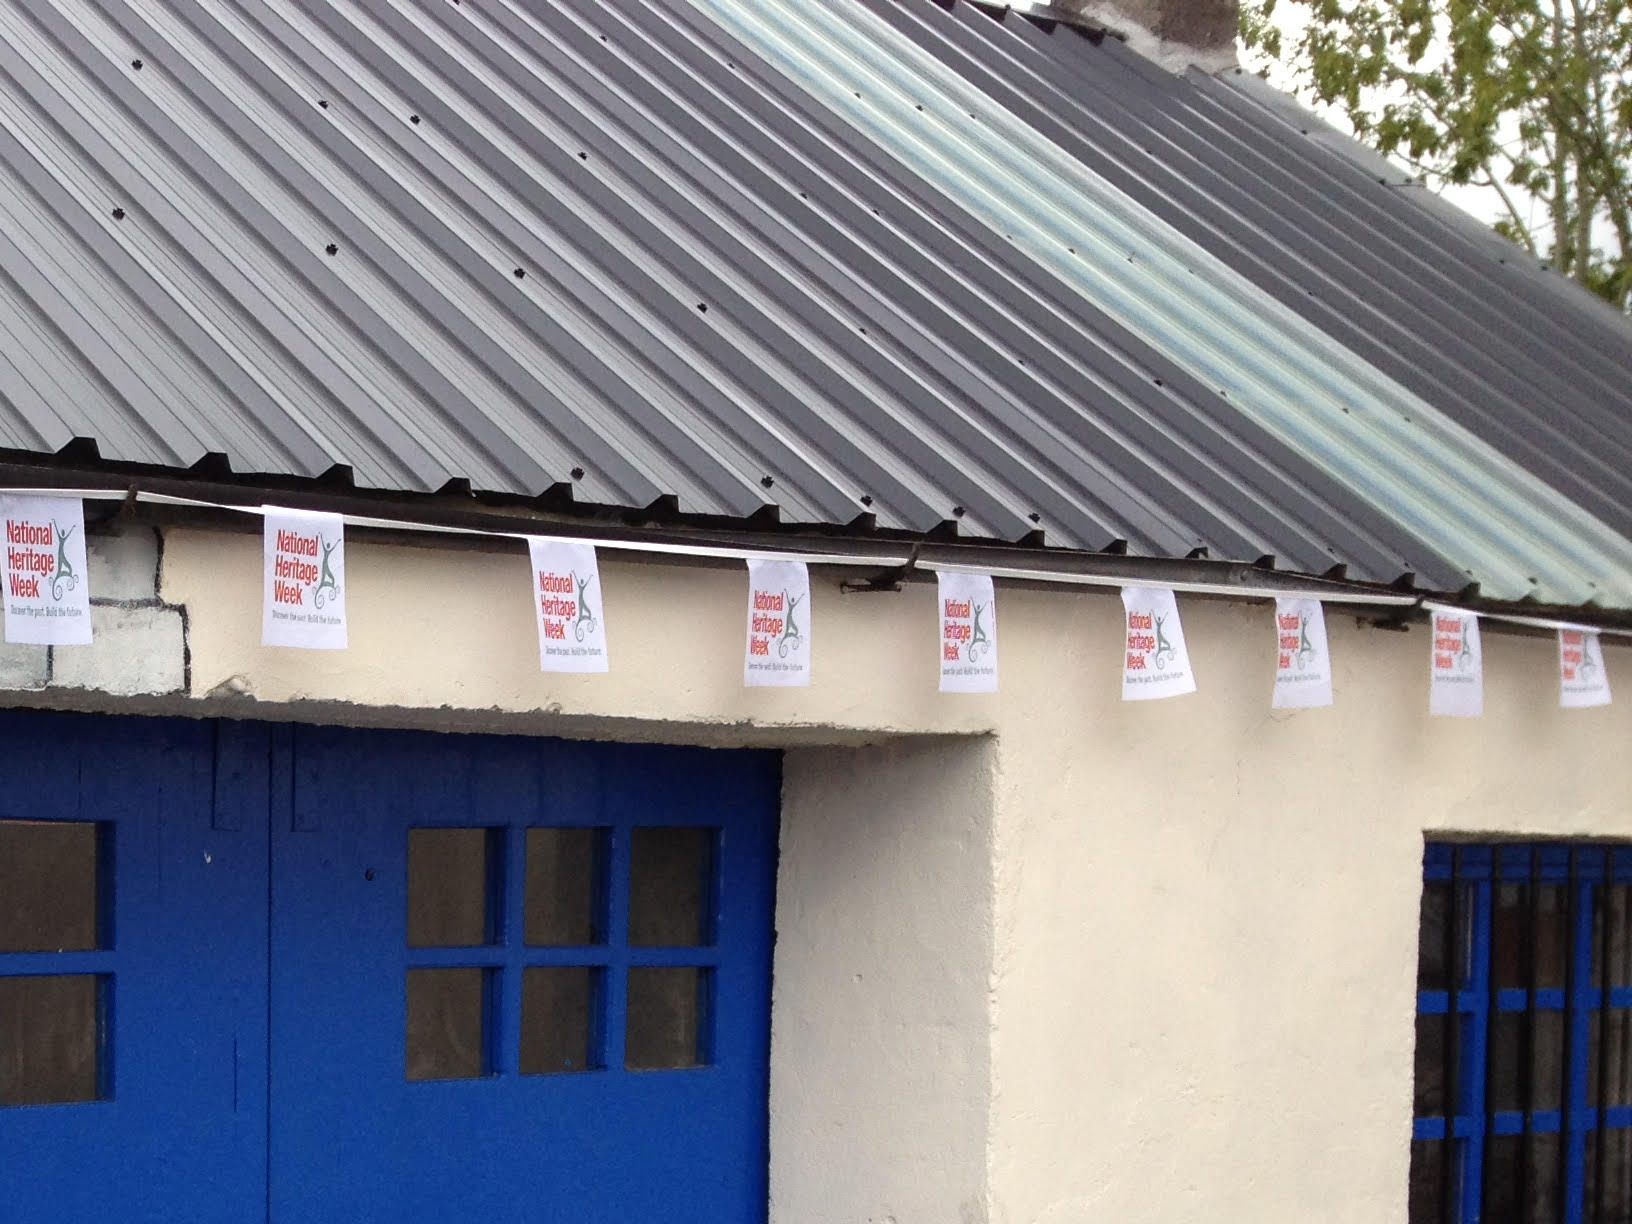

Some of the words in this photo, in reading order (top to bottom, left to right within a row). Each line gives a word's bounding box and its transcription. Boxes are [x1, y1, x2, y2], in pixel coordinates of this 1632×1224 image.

[6, 520, 53, 546] National
[276, 529, 319, 557] National
[7, 547, 54, 577] Heritage
[274, 554, 318, 586] Heritage
[9, 573, 40, 598] Week
[274, 579, 303, 606] Week
[539, 570, 573, 594] National
[540, 594, 576, 621] Heritage
[543, 617, 566, 640] Week
